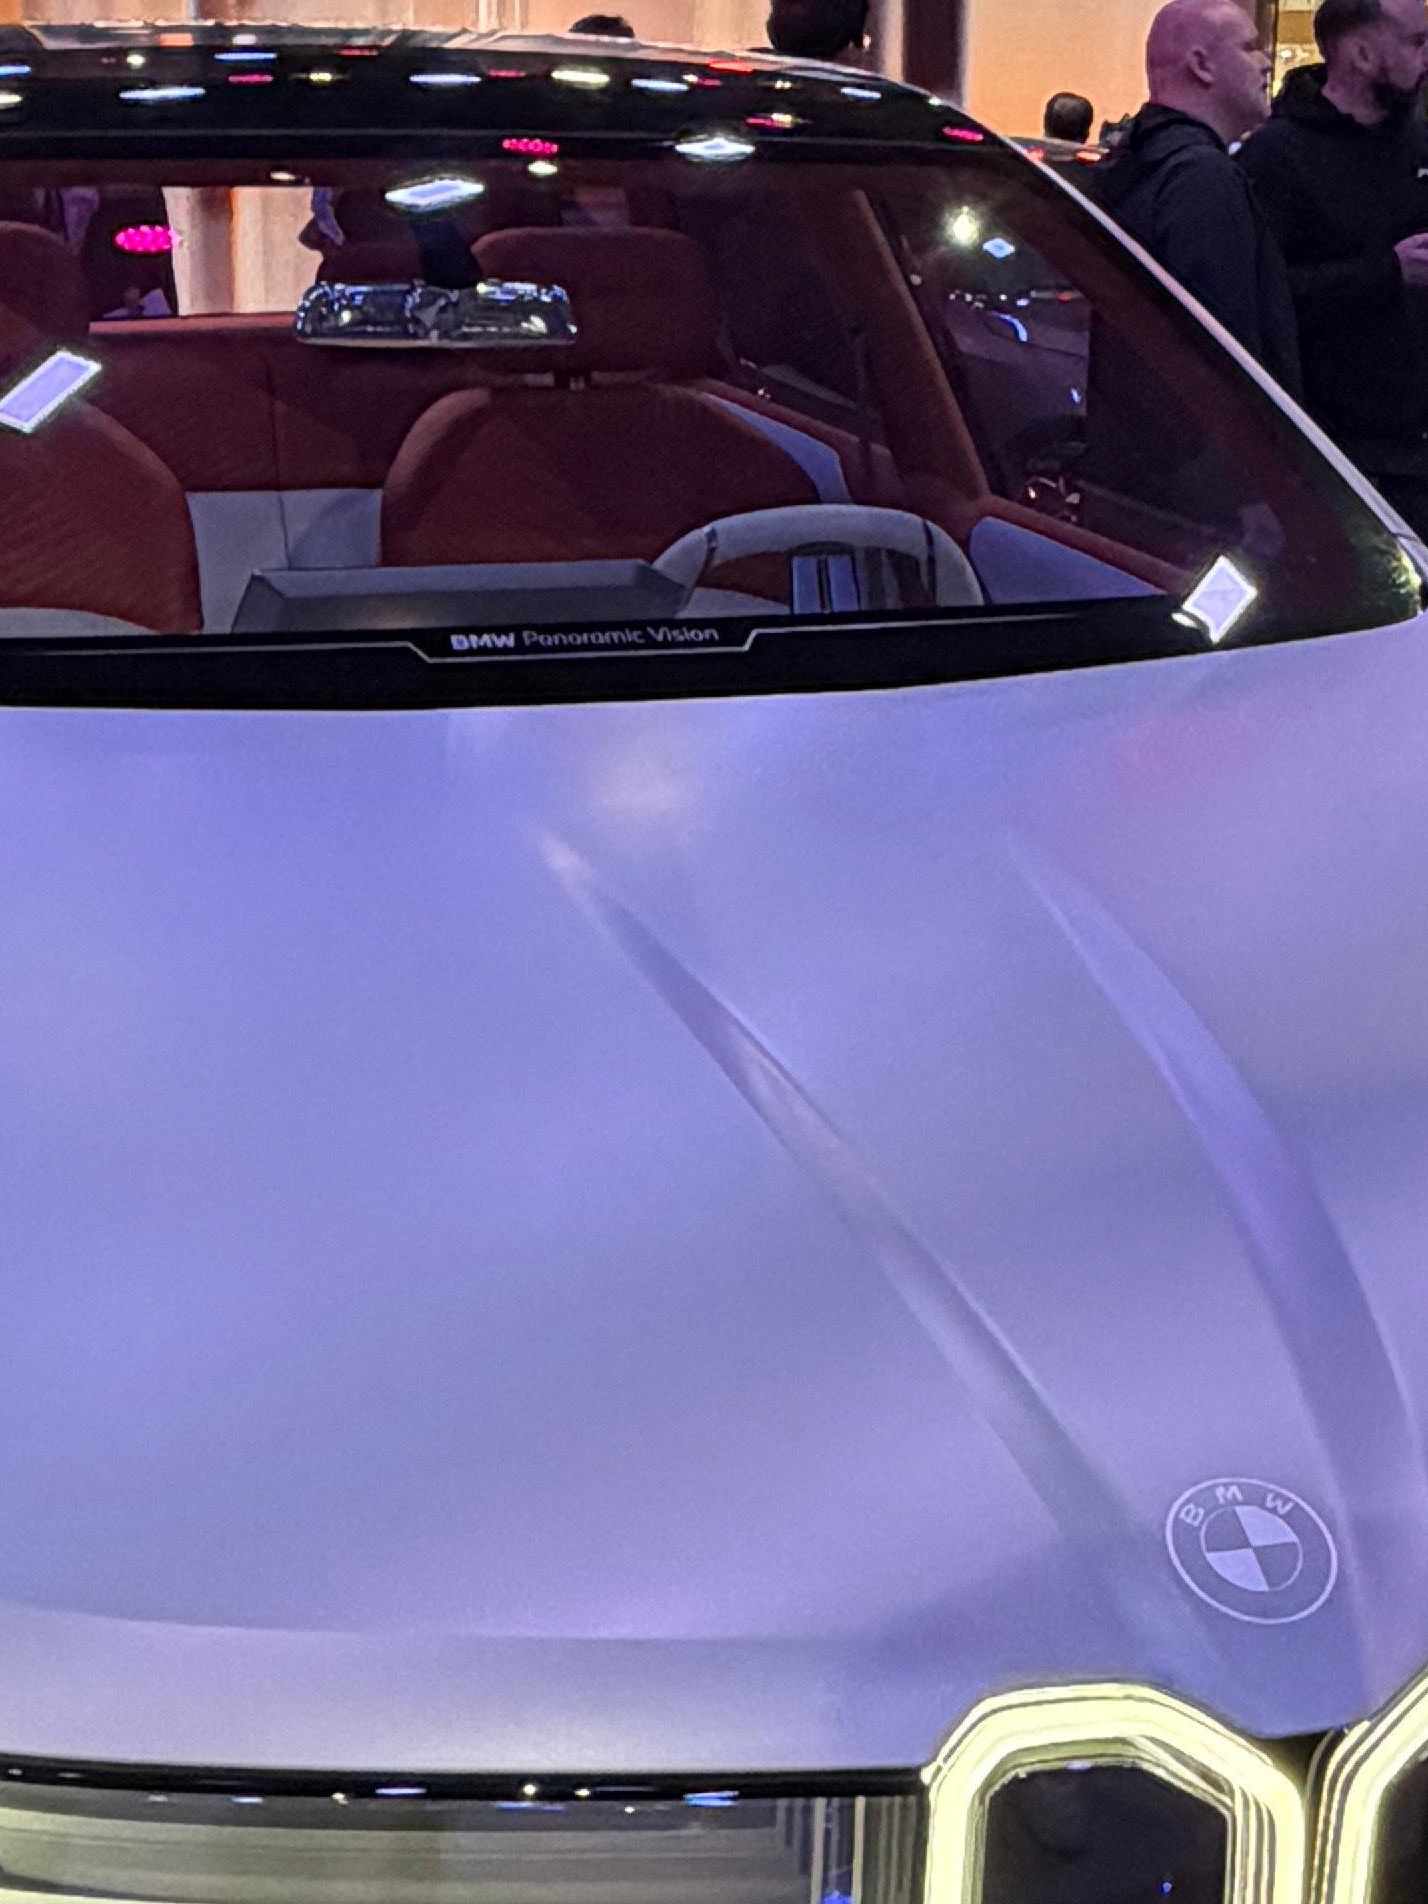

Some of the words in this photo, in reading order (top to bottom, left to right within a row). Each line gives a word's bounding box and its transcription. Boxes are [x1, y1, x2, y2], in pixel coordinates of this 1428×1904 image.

[451, 632, 515, 650] BMW
[522, 628, 646, 647] Panoramic
[647, 626, 719, 643] Vision
[1178, 1484, 1294, 1527] BMW
